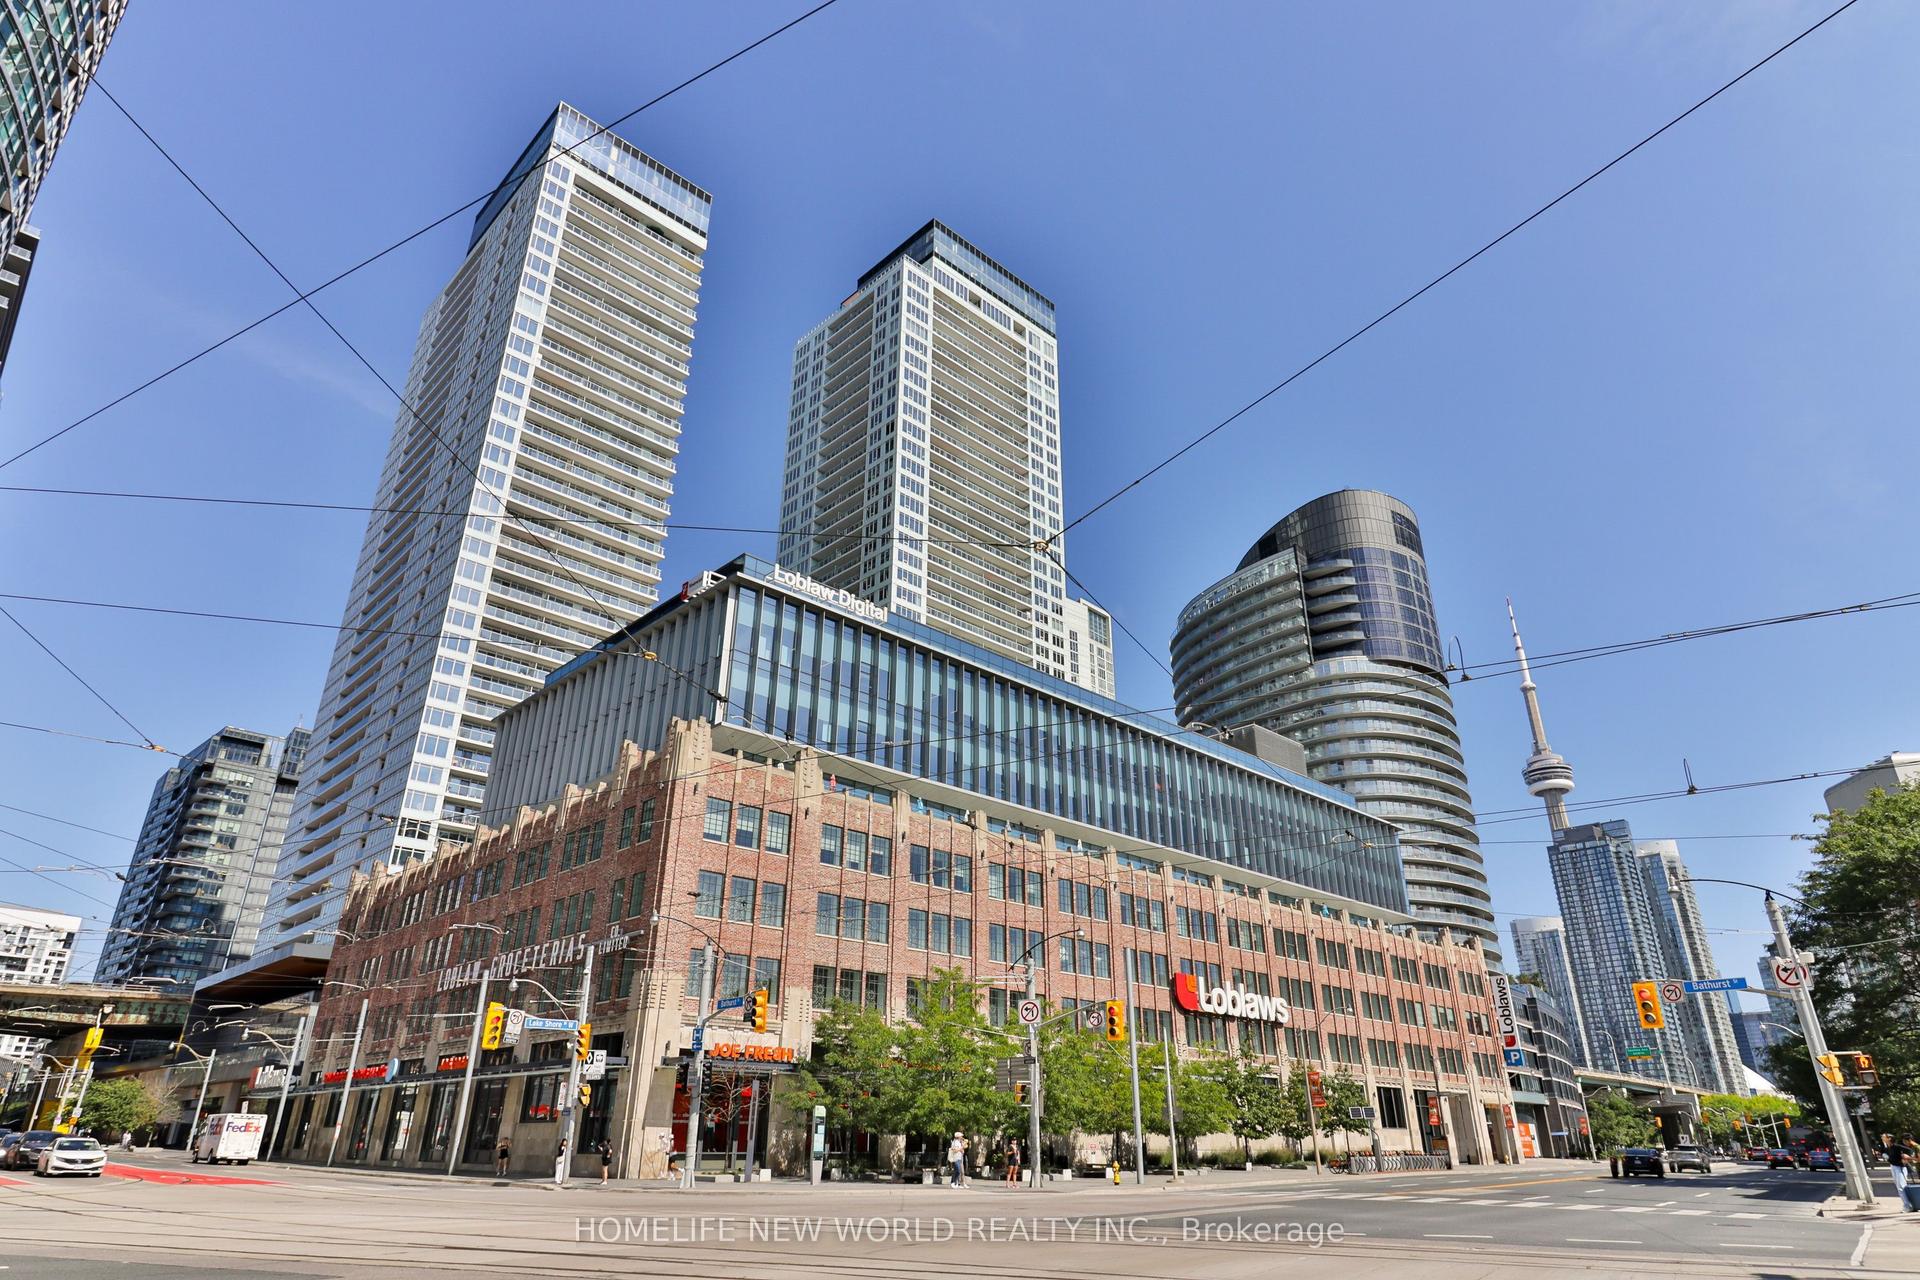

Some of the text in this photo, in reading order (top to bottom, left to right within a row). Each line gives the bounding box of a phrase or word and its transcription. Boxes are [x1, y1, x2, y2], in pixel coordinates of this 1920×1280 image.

[774, 563, 888, 623] Loblaw Digital
[598, 935, 629, 955] LIMITED
[437, 934, 586, 992] LOBLAW GROCETERIAS
[1692, 979, 1731, 990] Bathurst
[1198, 975, 1289, 1024] Loblaws
[1496, 977, 1514, 1034] Loblaws
[528, 1019, 543, 1028] Lake
[544, 1019, 563, 1028] Shore
[710, 1042, 794, 1063] JOE FRESH
[1510, 1051, 1520, 1064] P
[226, 1121, 262, 1133] FedEx
